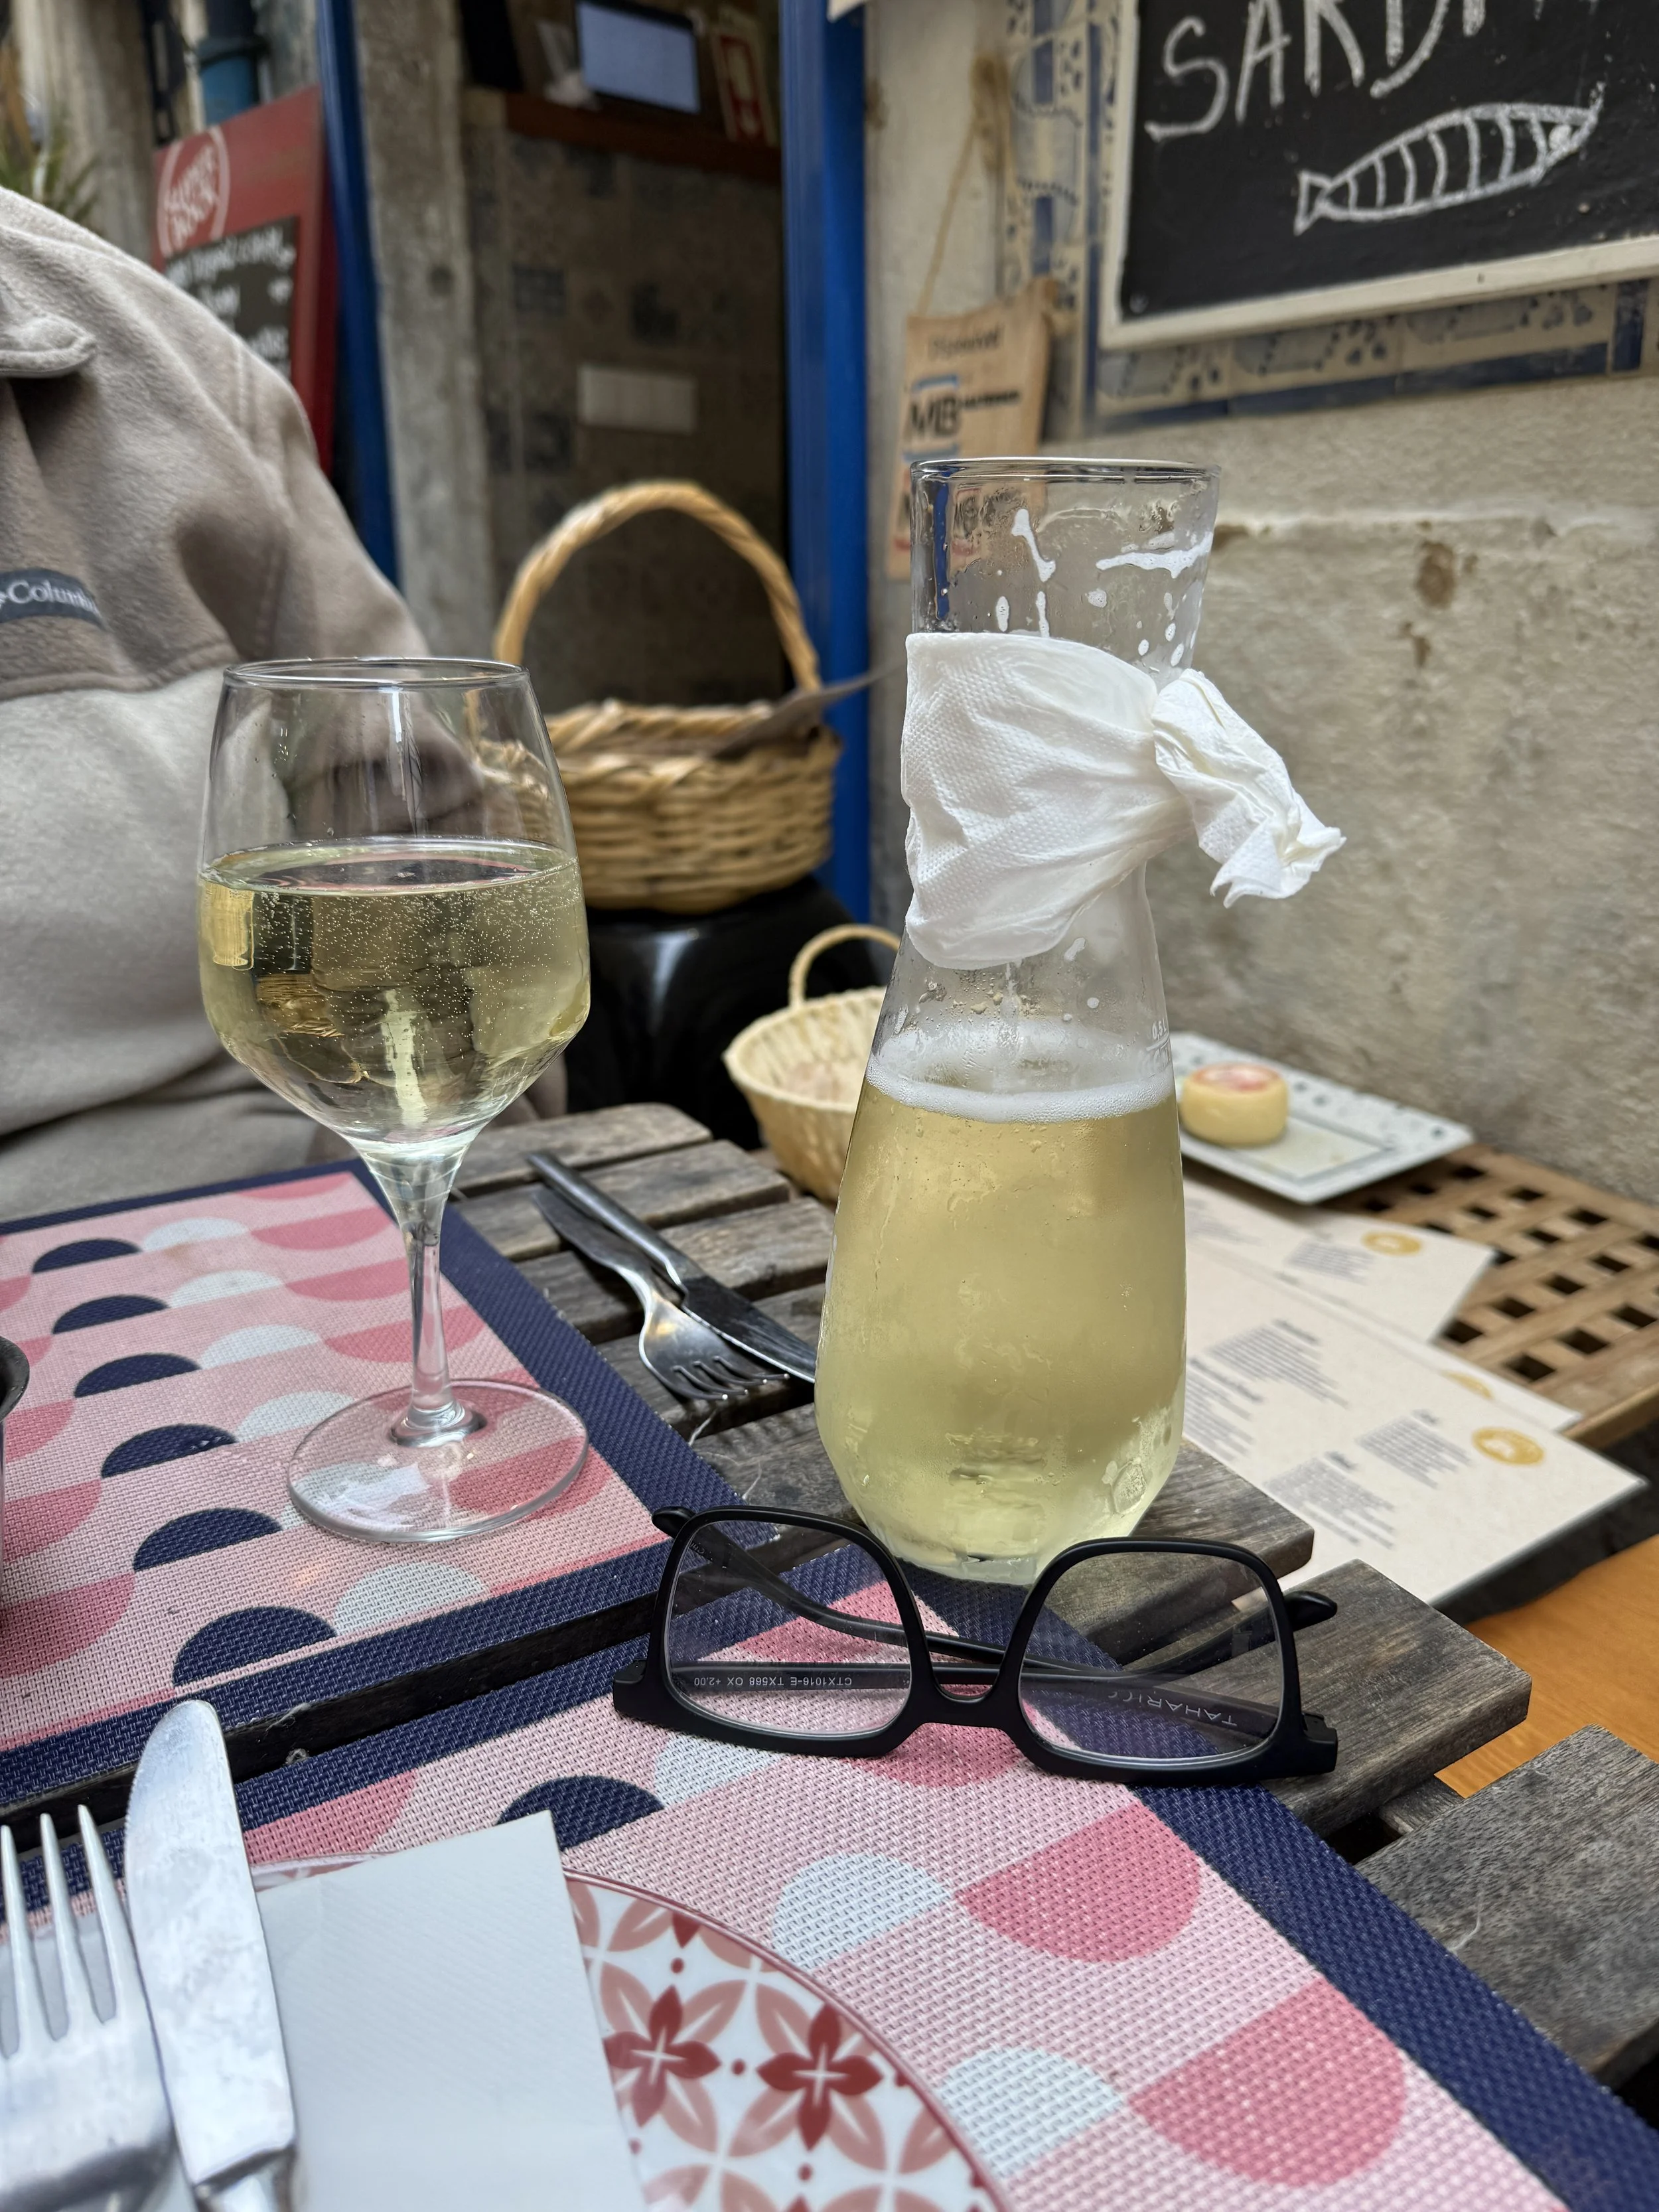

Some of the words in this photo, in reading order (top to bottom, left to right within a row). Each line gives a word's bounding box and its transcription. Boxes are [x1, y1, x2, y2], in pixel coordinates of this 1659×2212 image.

[694, 1677, 721, 1686] +2.00
[727, 1677, 744, 1686] OX
[749, 1677, 784, 1686] TX568
[790, 1677, 852, 1686] CTX1016-E
